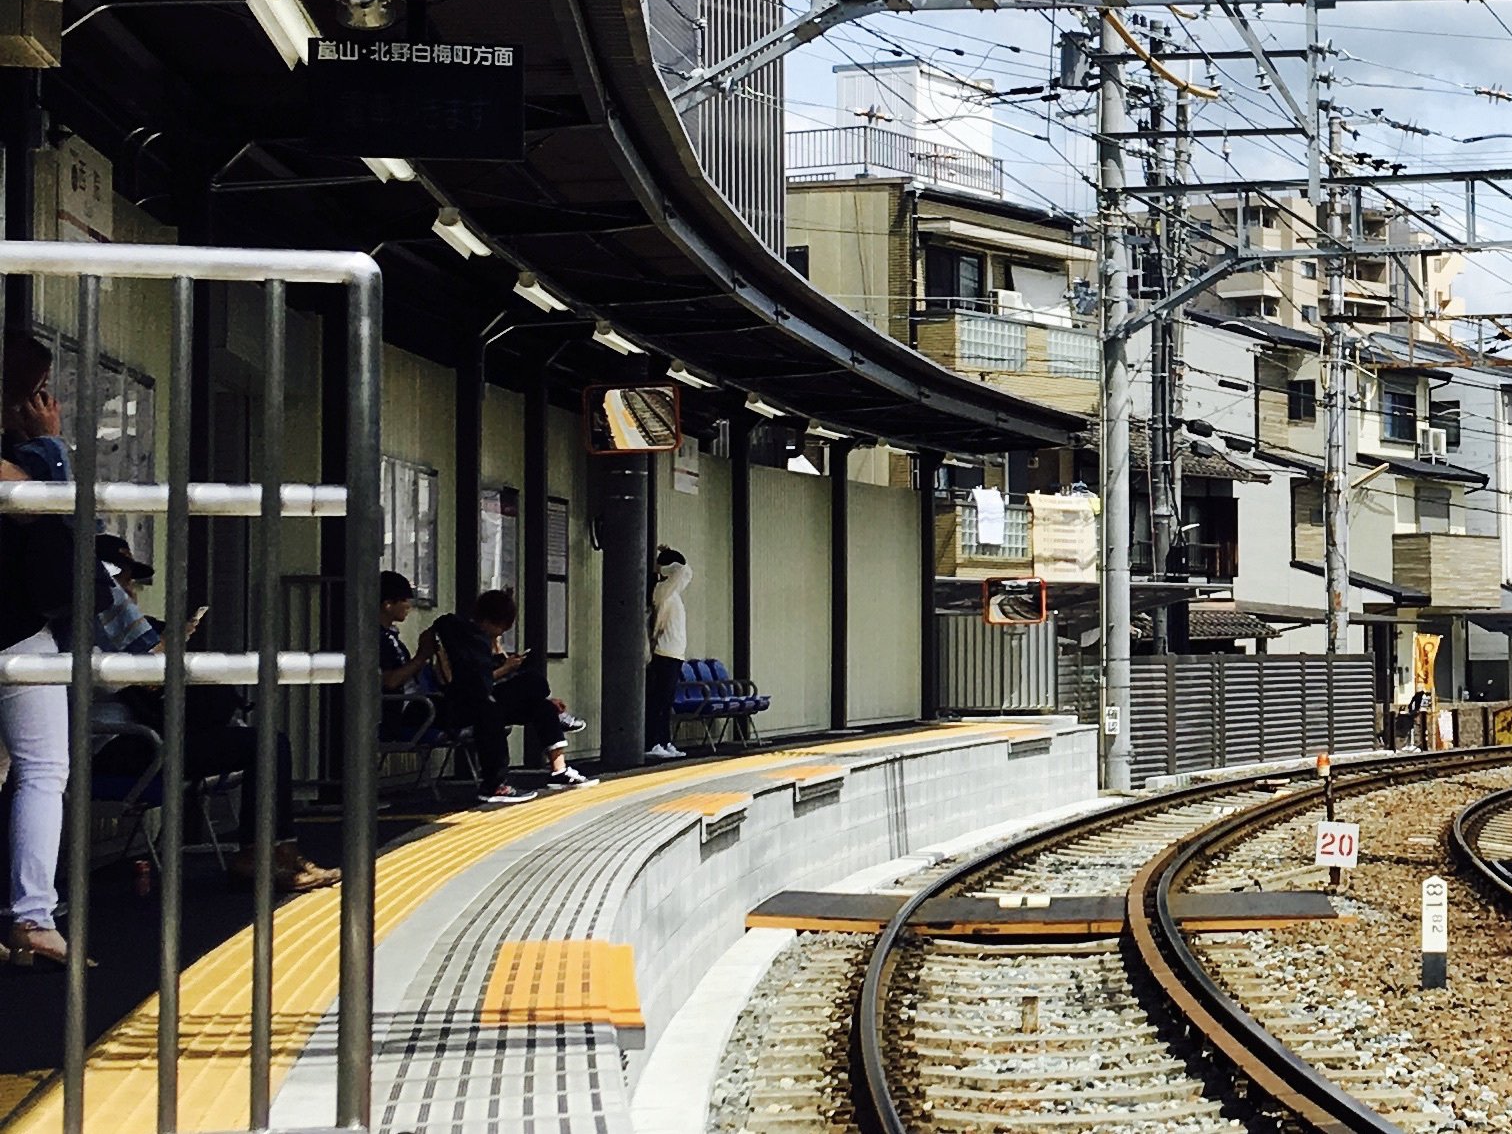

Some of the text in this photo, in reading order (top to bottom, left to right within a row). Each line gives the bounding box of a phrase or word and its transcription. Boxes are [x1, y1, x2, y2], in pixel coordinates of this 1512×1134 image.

[317, 40, 513, 66] 嵐山・北野白梅町方面
[1320, 832, 1353, 857] 20
